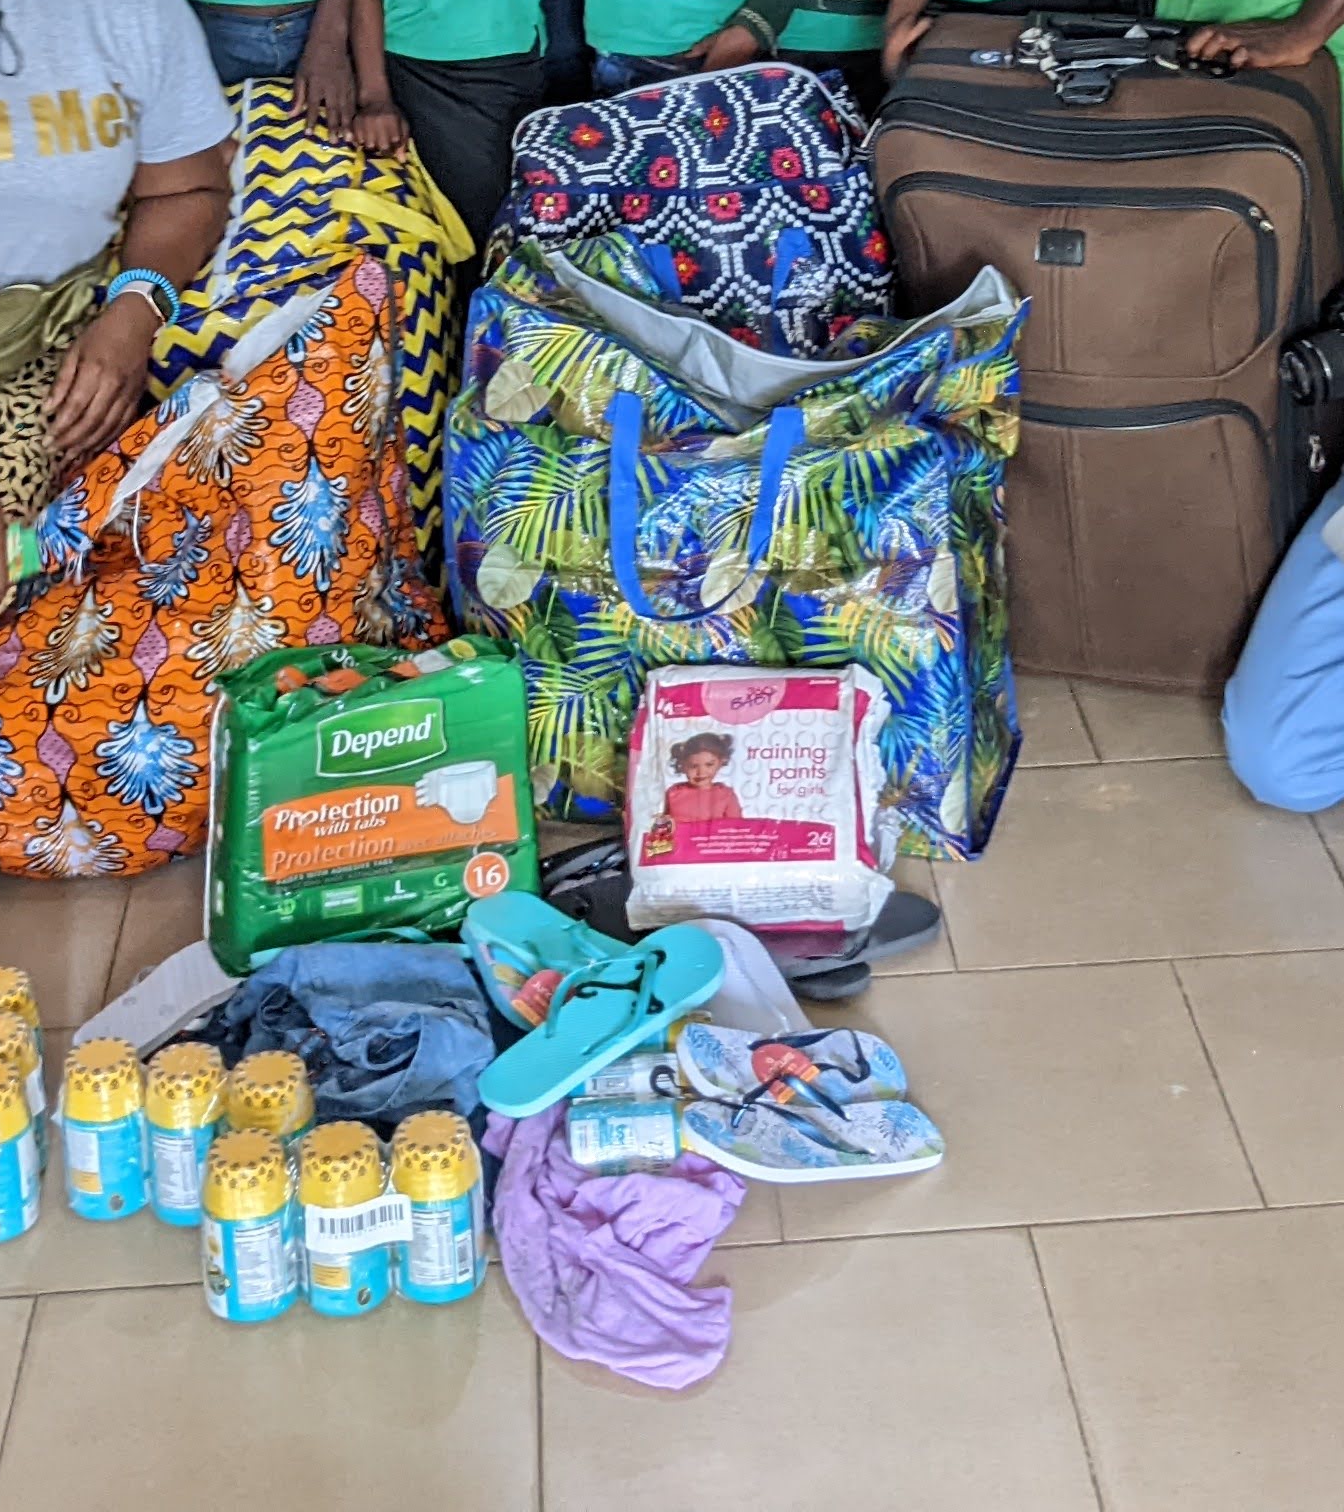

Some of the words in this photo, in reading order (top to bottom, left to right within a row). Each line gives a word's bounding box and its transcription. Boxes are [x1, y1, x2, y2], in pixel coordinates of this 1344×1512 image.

[331, 712, 432, 759] Depend
[747, 742, 827, 765] training
[769, 764, 827, 787] pants
[273, 791, 400, 832] Protection
[314, 819, 351, 838] with
[353, 814, 388, 832] tabs
[271, 833, 396, 874] Protection
[472, 864, 502, 888] 16
